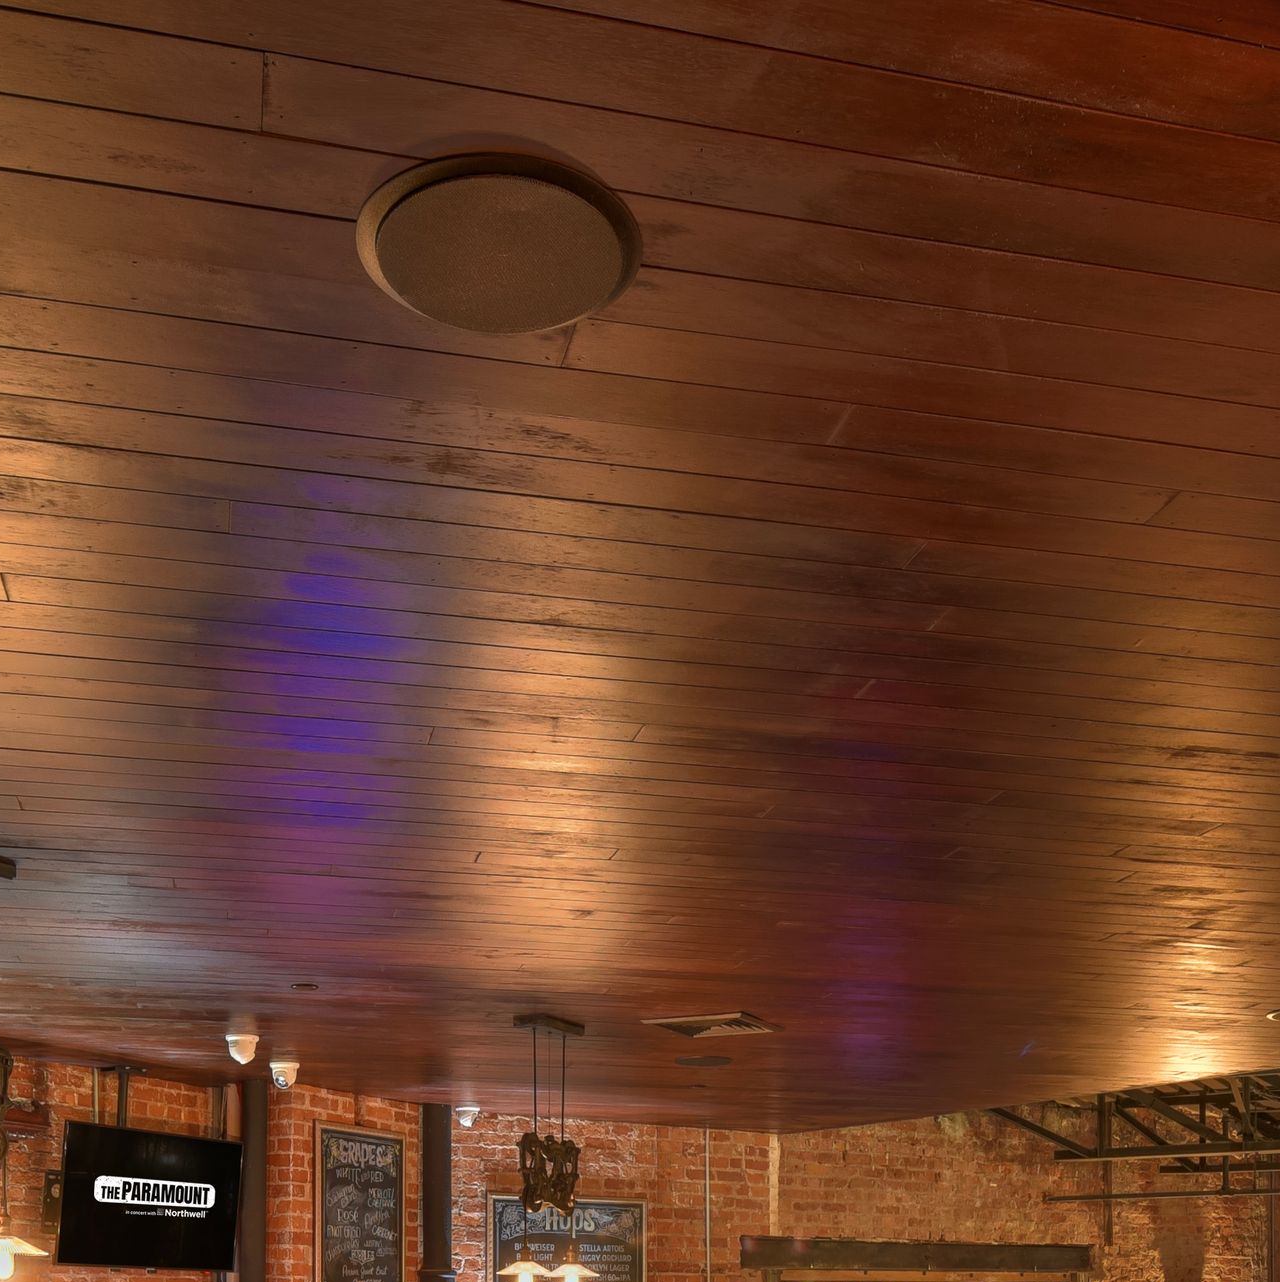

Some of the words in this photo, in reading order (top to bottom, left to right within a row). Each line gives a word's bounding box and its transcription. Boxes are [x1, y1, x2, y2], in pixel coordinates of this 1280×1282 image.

[339, 1139, 385, 1168] GRAPES
[101, 1186, 121, 1200] THE
[121, 1181, 210, 1205] PARAMOUNT
[165, 1209, 206, 1218] Northwell
[578, 1244, 601, 1252] STELLA
[603, 1244, 625, 1252] ARTOIS
[534, 1253, 553, 1261] LIGHT
[578, 1254, 601, 1262] ANGRY
[602, 1254, 632, 1262] ORCHARD
[609, 1264, 630, 1272] LAGER
